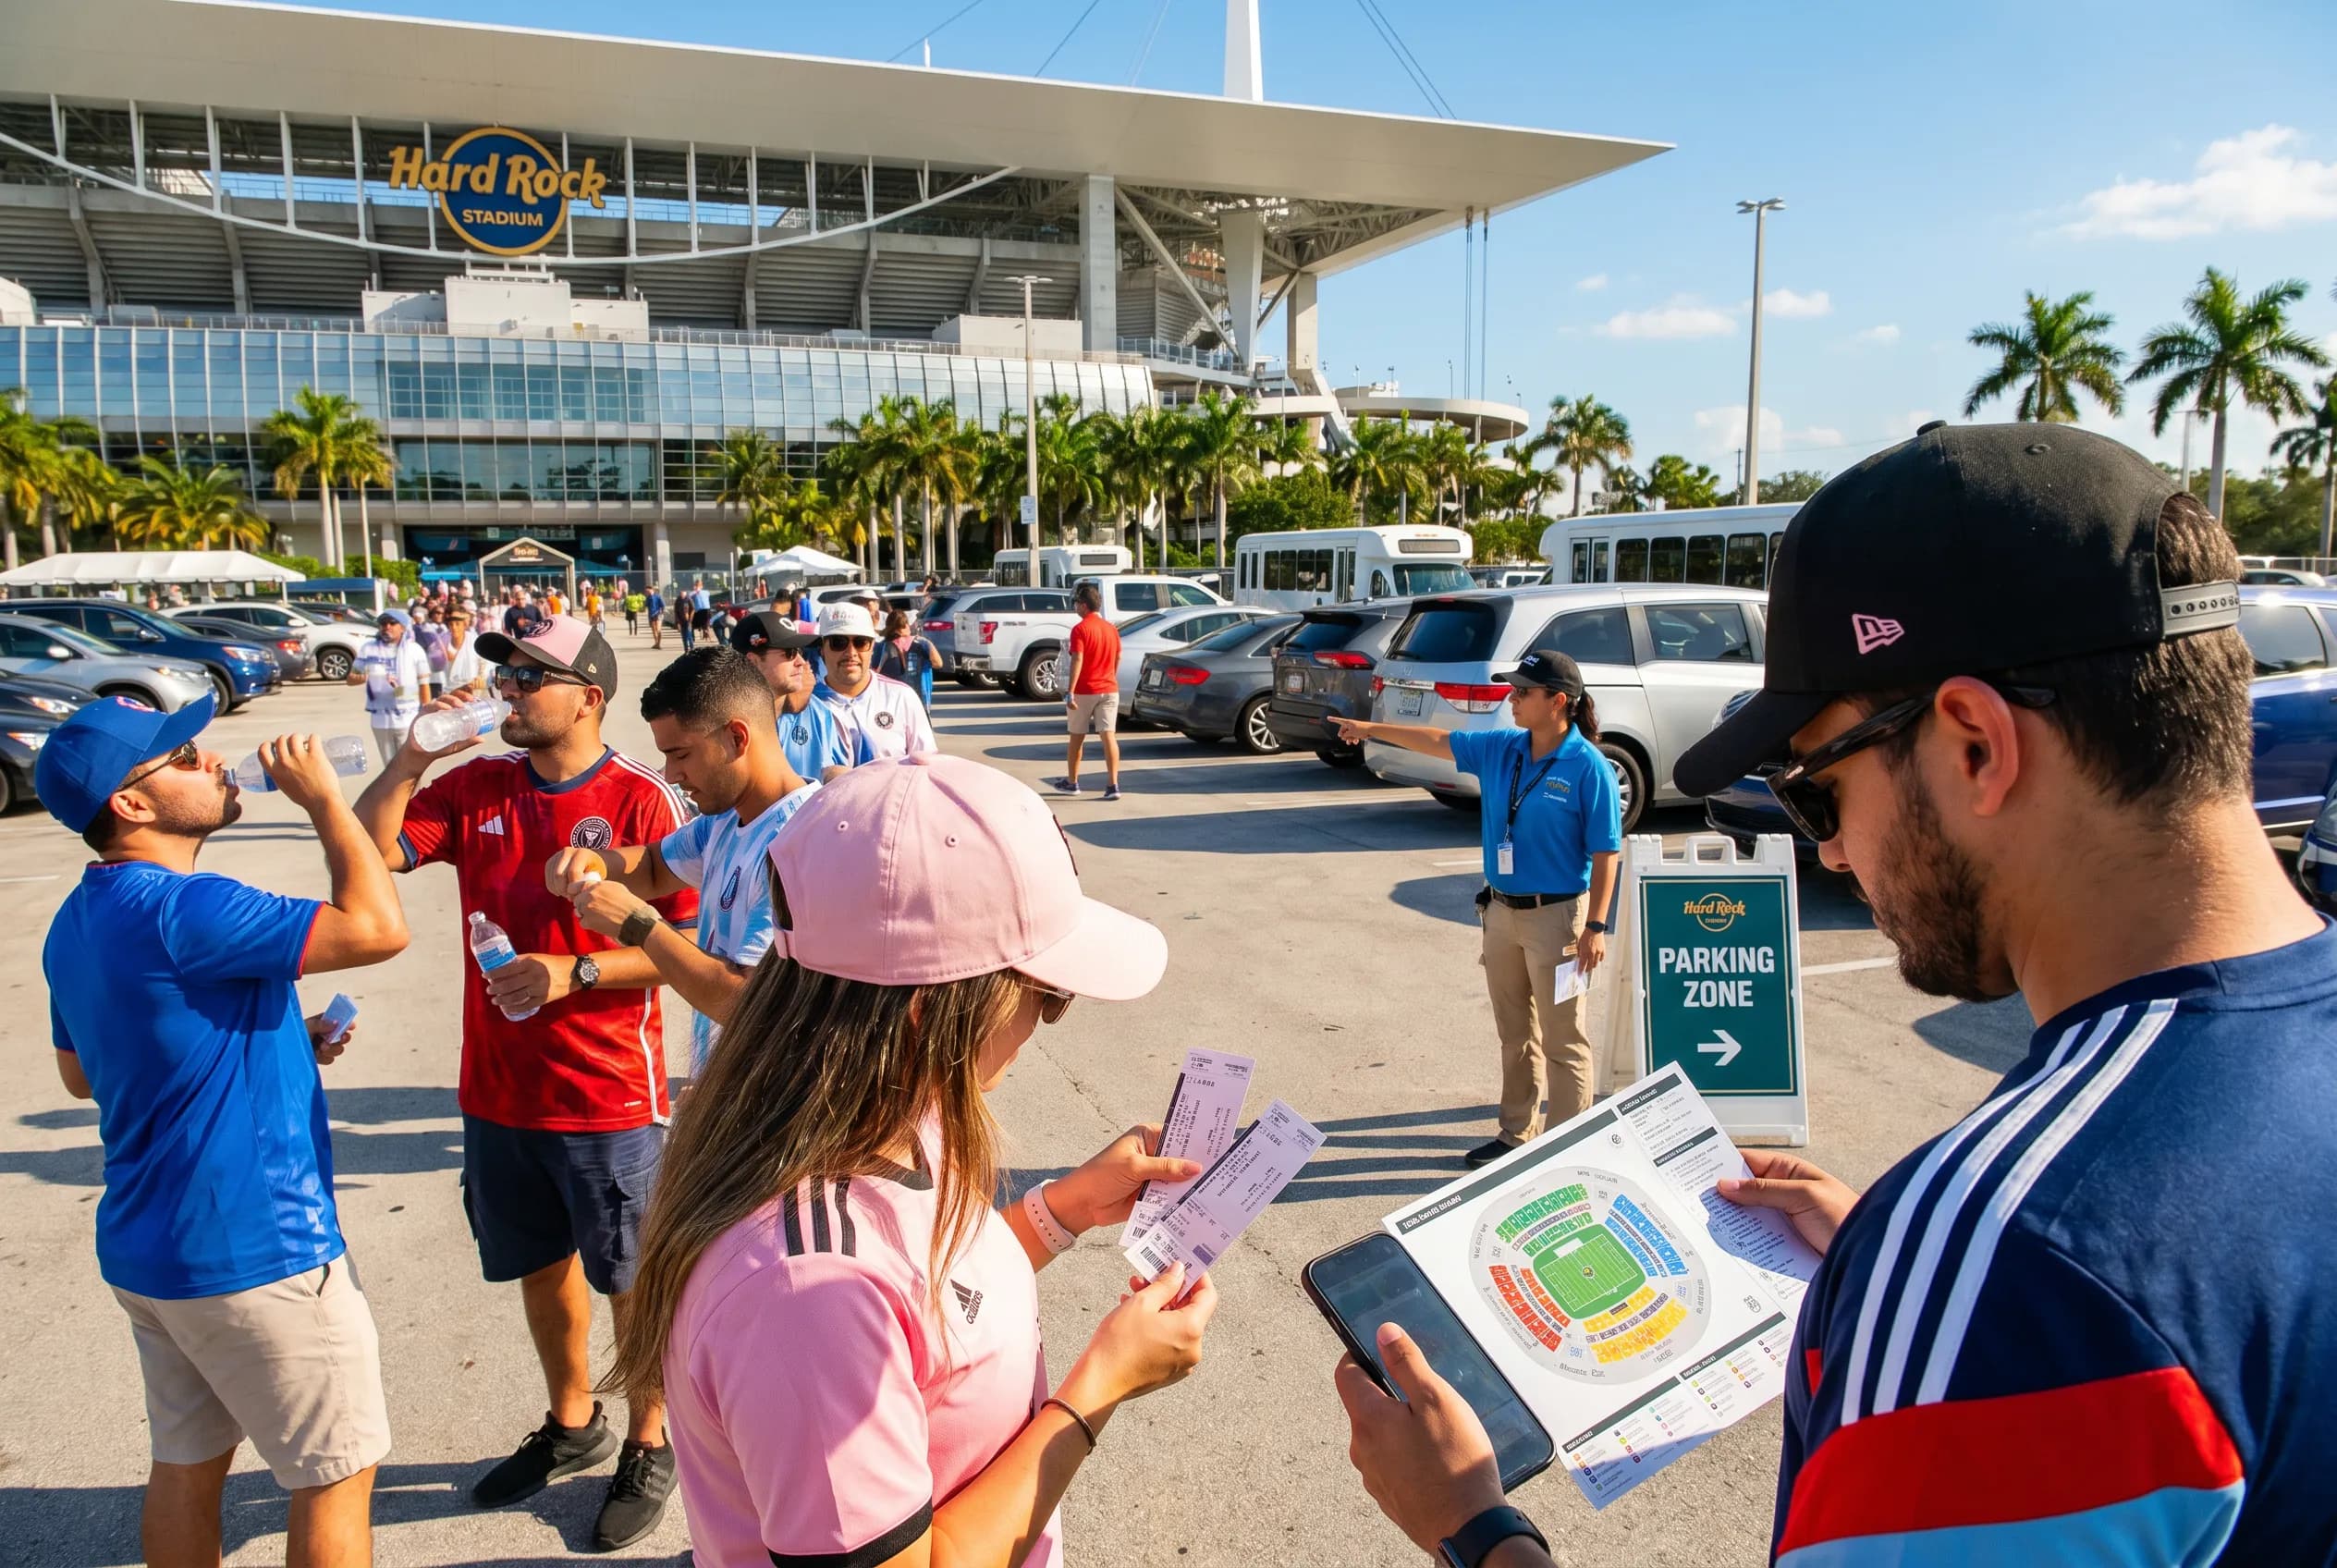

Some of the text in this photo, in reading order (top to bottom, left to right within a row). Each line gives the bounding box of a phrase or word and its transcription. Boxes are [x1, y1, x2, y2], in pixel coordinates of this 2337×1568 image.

[388, 145, 606, 209] Hard Rock
[462, 209, 544, 227] STADIUM
[1658, 946, 1776, 974] PARKING
[1683, 980, 1754, 1008] ZONE
